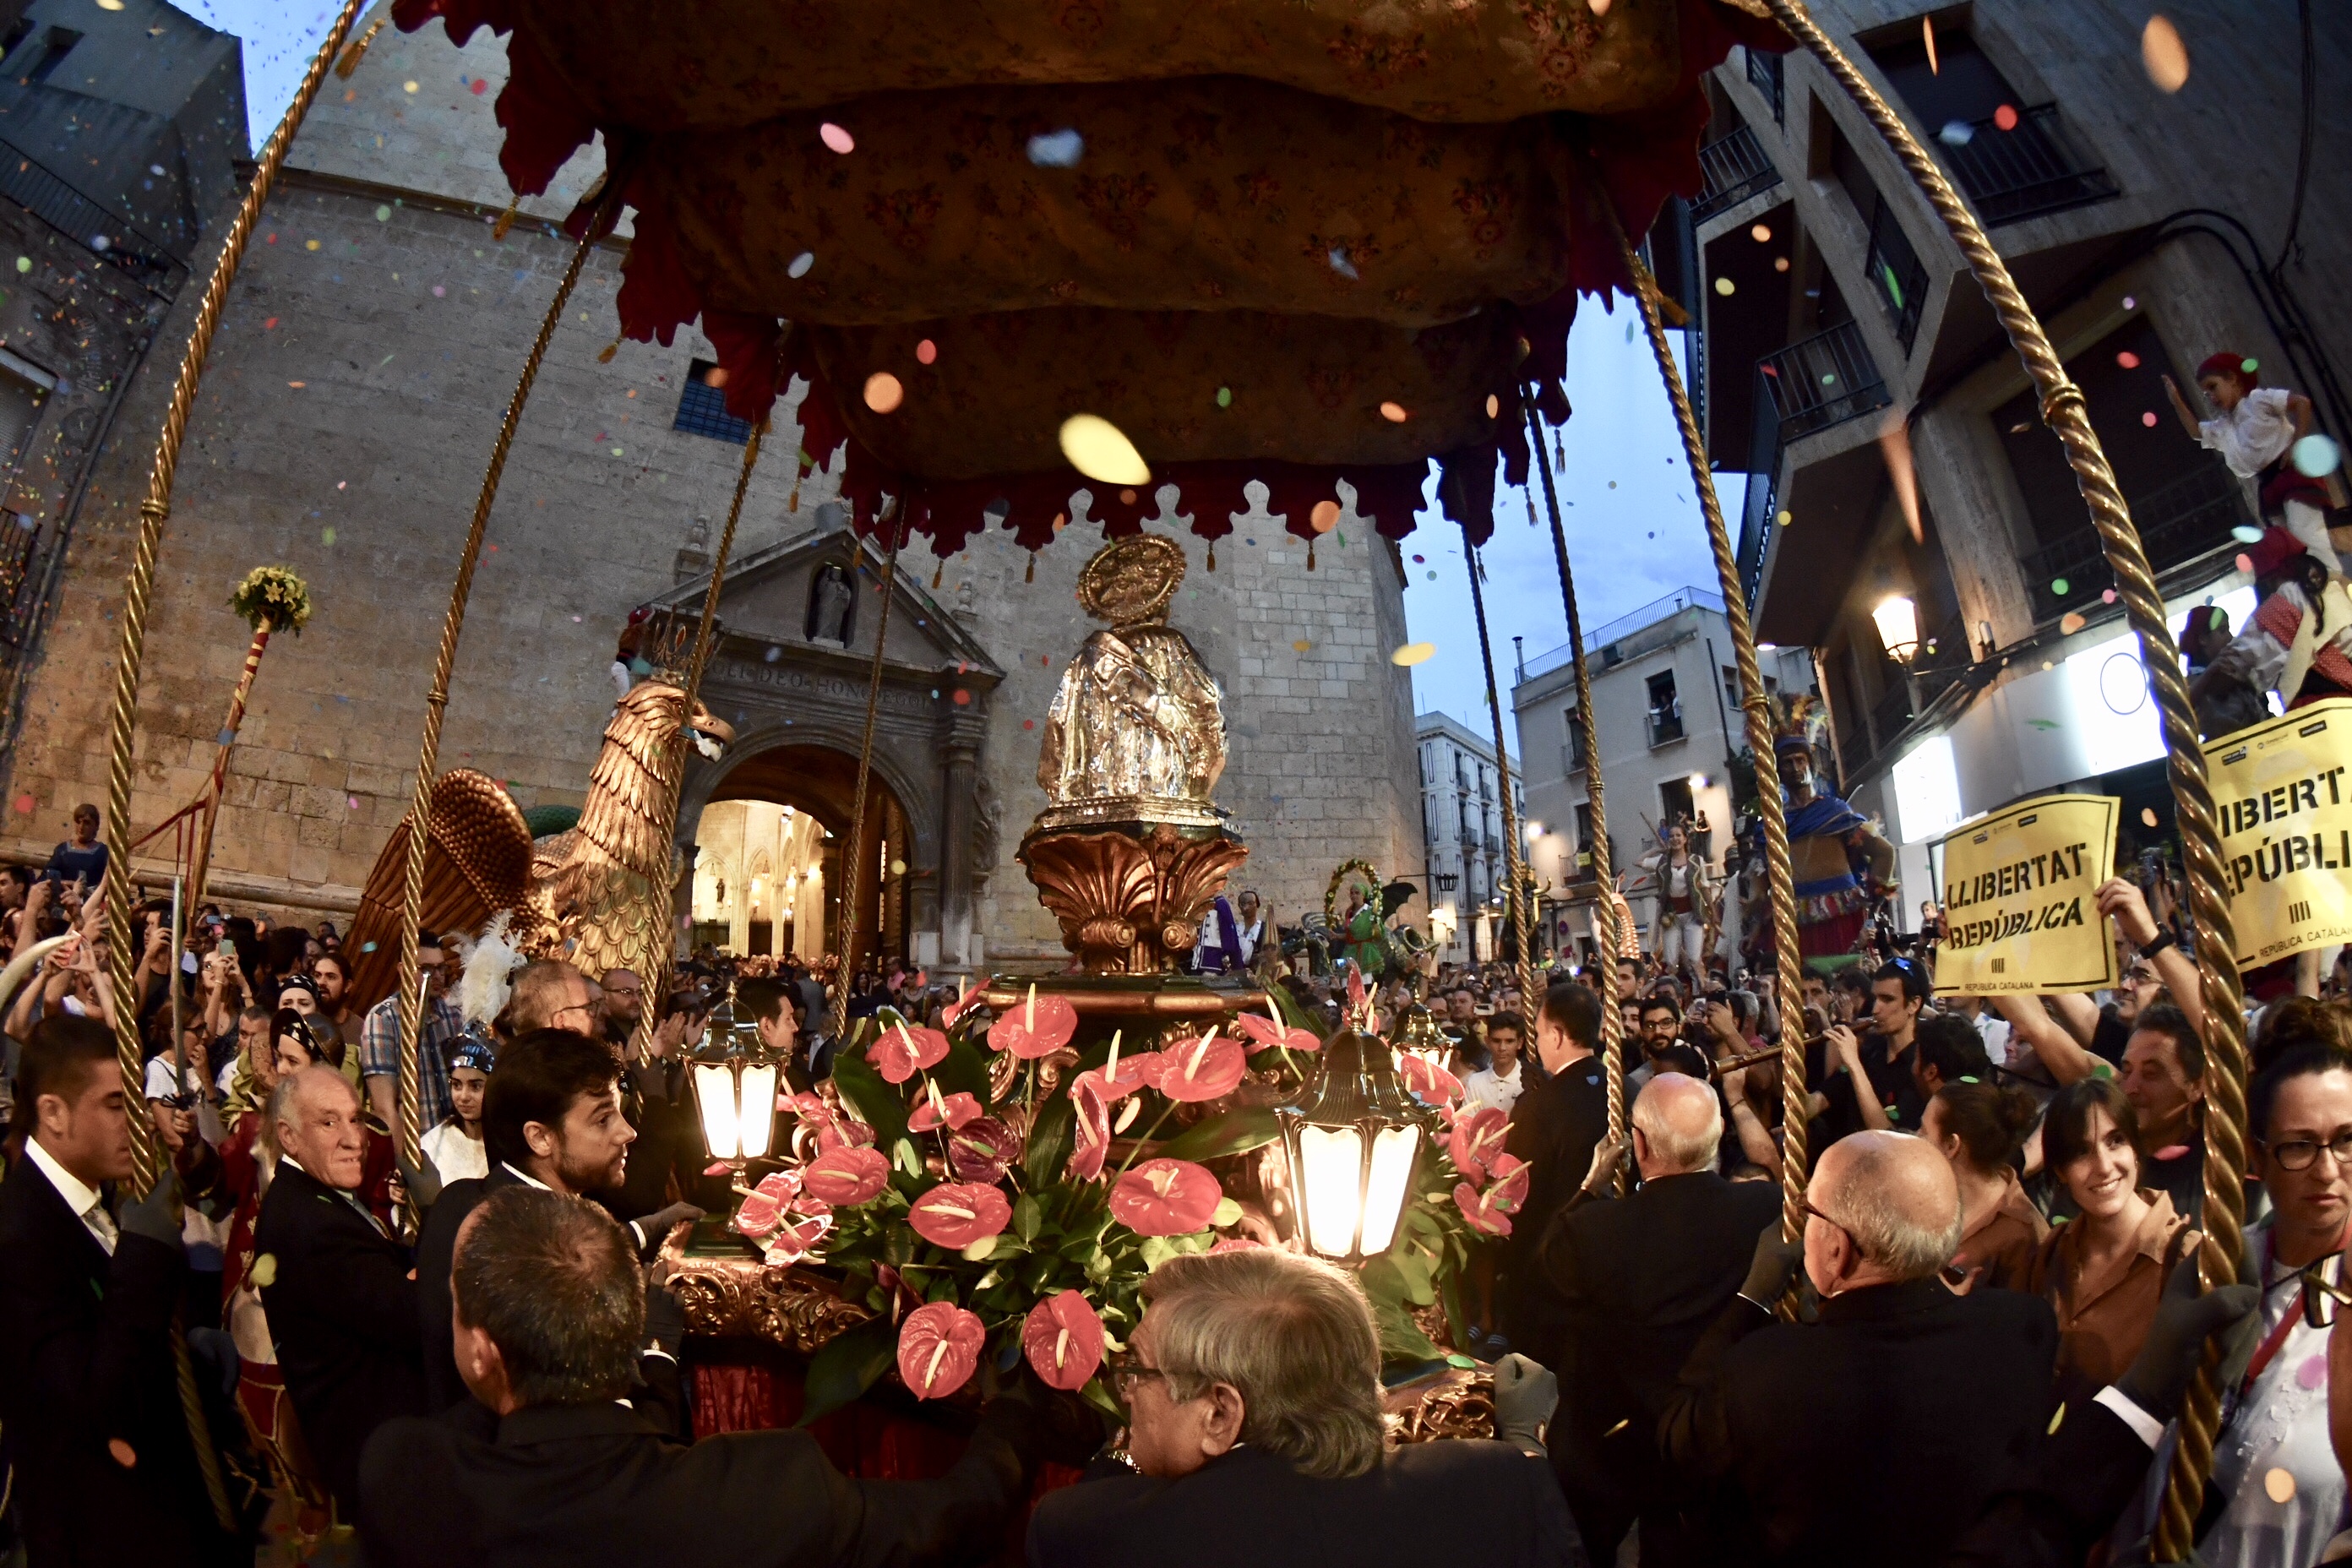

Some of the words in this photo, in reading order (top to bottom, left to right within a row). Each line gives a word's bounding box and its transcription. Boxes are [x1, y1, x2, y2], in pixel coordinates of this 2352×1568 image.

[2219, 765, 2352, 838] IBERT
[1946, 841, 2087, 912] LLIBERTAT
[1948, 896, 2084, 950] REPÚBLICA
[2306, 927, 2352, 943] CATALAN
[1999, 981, 2034, 990] CATALANA
